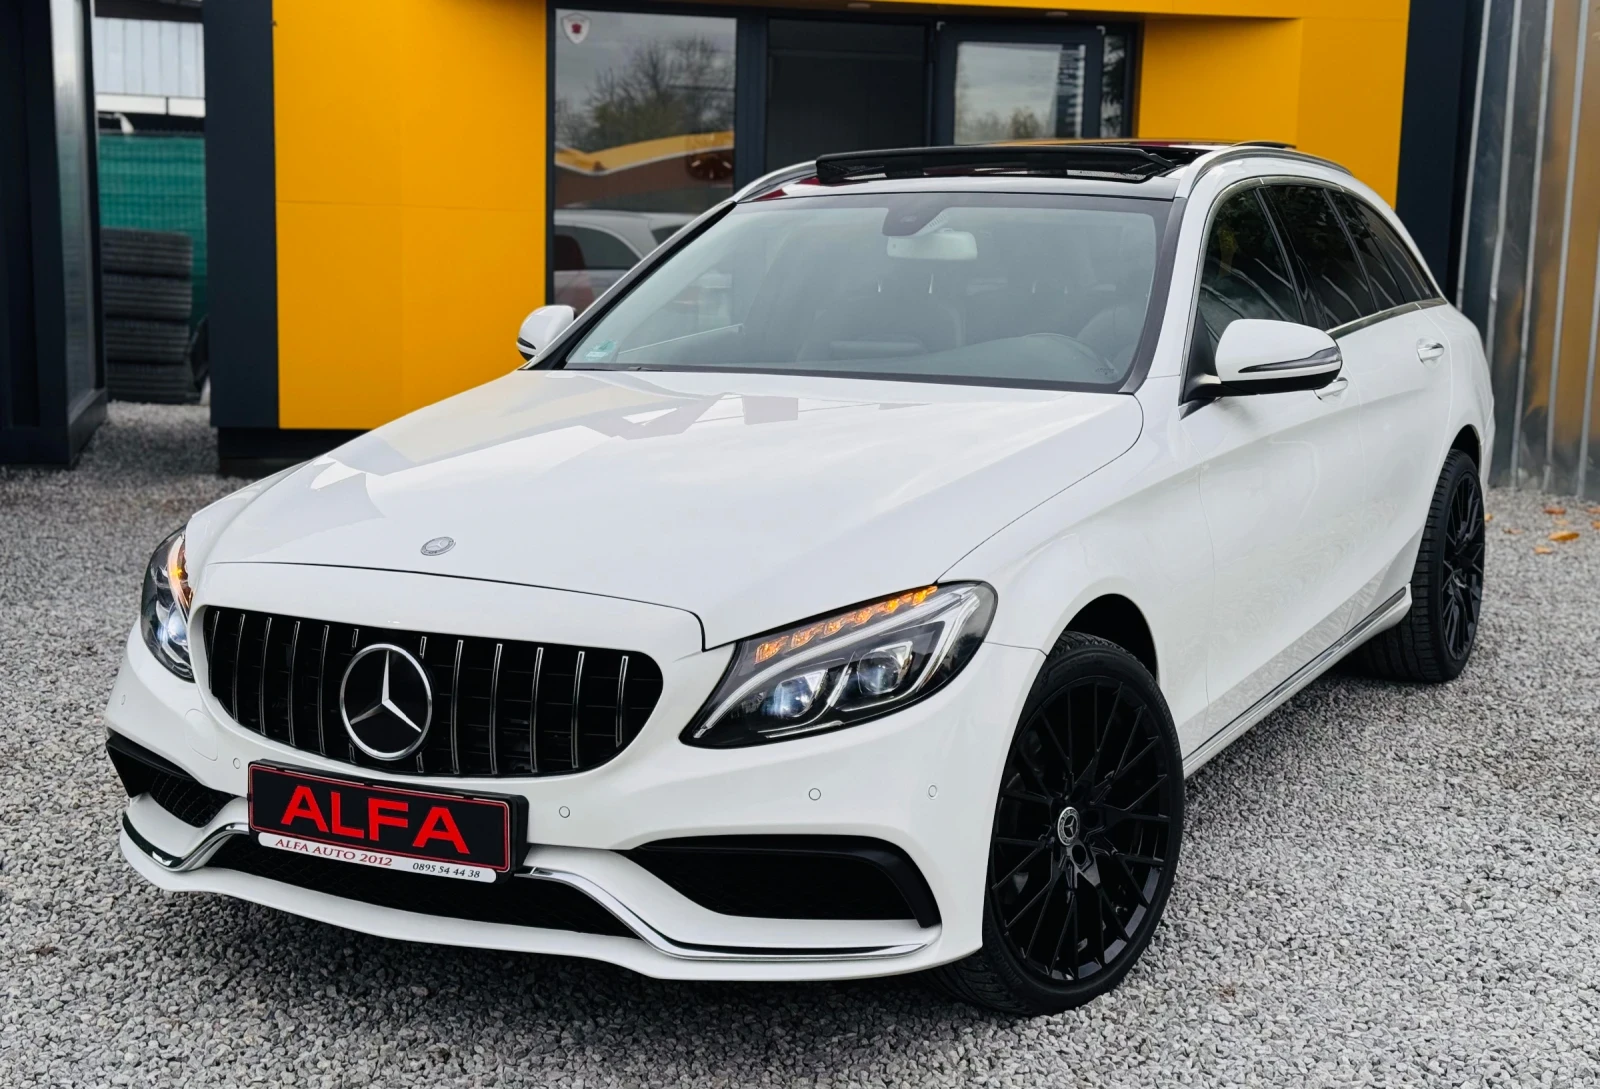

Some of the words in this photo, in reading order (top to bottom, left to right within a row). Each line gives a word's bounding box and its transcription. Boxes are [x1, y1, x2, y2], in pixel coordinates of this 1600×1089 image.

[281, 785, 471, 855] ALFA
[275, 839, 309, 852] ALFA
[312, 846, 356, 860] AUTO
[359, 853, 393, 866] 2012
[412, 862, 437, 873] 0895
[438, 865, 450, 875] 54
[453, 868, 466, 877] 44
[468, 869, 481, 879] 38
